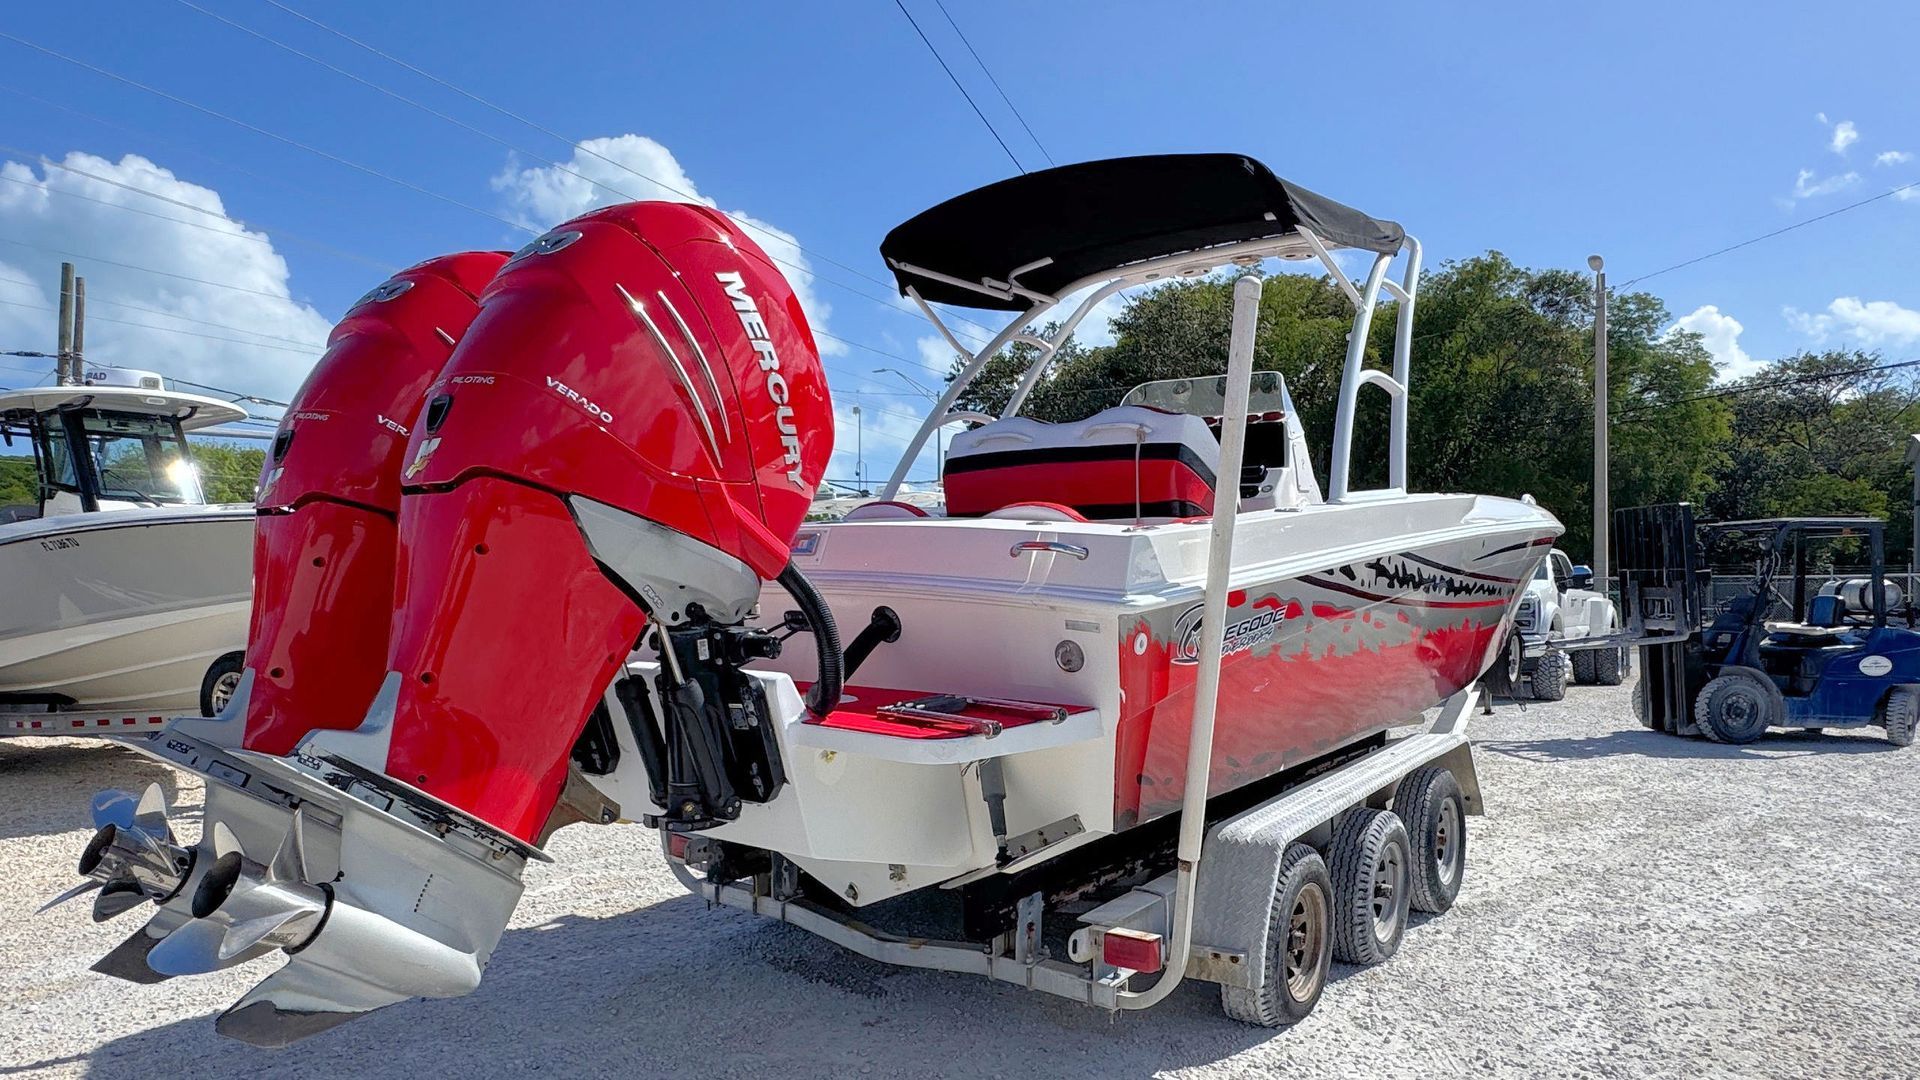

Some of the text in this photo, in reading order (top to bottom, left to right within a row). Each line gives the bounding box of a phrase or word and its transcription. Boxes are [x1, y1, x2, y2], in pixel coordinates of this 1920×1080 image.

[85, 372, 107, 380] RAD
[451, 376, 495, 385] PILOTING
[714, 271, 804, 490] MERCURY
[546, 375, 613, 424] VERADO
[378, 414, 410, 436] VER
